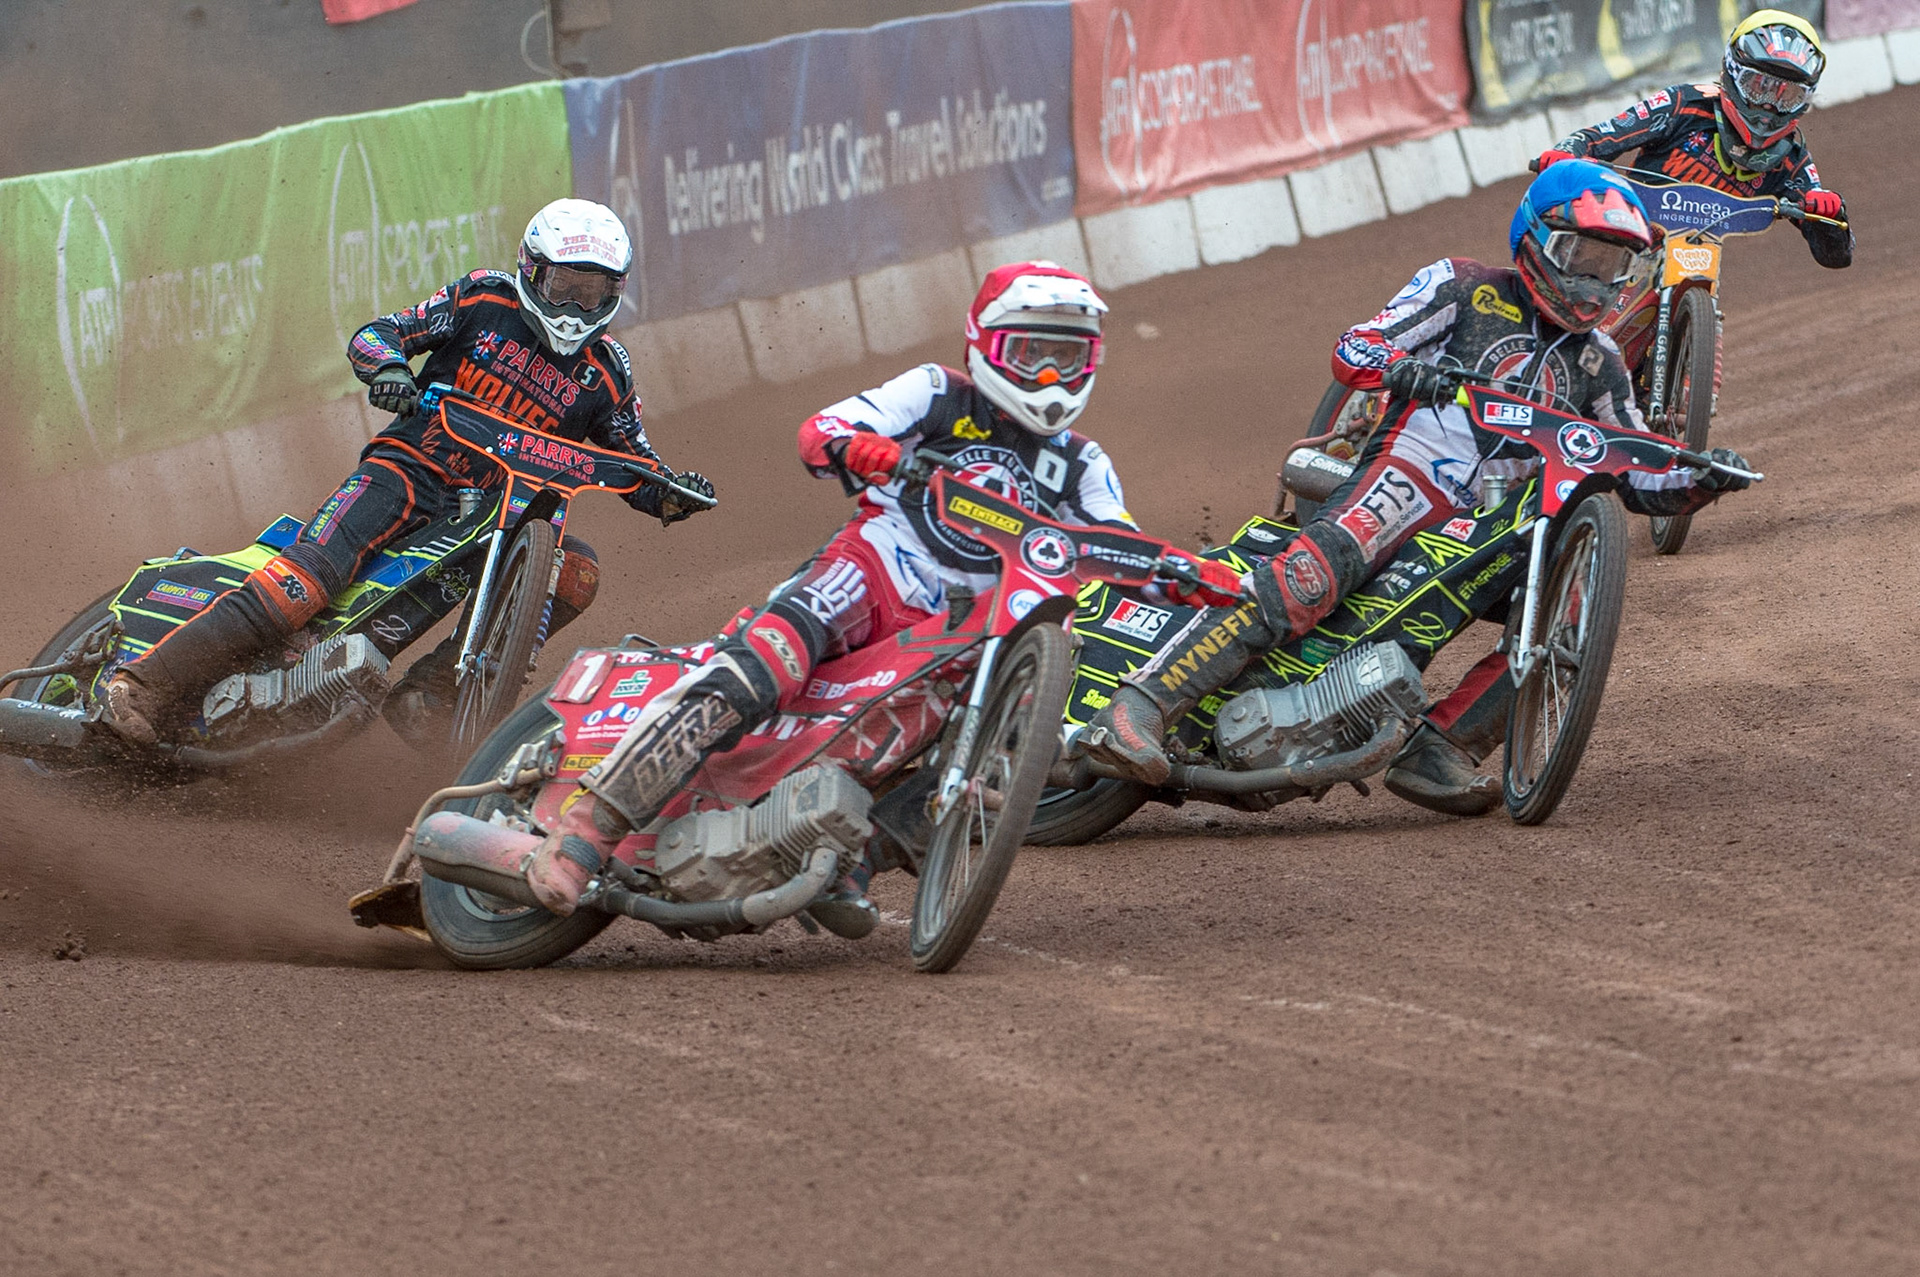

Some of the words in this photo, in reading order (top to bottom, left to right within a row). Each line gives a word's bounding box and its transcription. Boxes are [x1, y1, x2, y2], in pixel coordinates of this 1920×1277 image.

[664, 141, 766, 244] Delivering
[766, 124, 830, 218] World
[830, 114, 886, 201] Class
[885, 95, 954, 187] Travel
[555, 243, 591, 258] WITH
[562, 234, 588, 246] THE
[1659, 305, 1671, 331] THE
[1488, 340, 1527, 364] BELLE
[1656, 336, 1668, 362] GAS
[497, 338, 581, 407] PARRYS
[580, 366, 597, 386] 5
[1653, 365, 1665, 403] SHOP
[1501, 405, 1530, 419] FTS
[520, 434, 596, 476] PARRYS
[956, 449, 992, 467] ELLE
[1360, 470, 1416, 527] FTS
[156, 582, 187, 597] CARPETS
[1458, 552, 1513, 601] ETHERIDGE
[1126, 605, 1170, 632] FTS
[568, 653, 608, 702] 1
